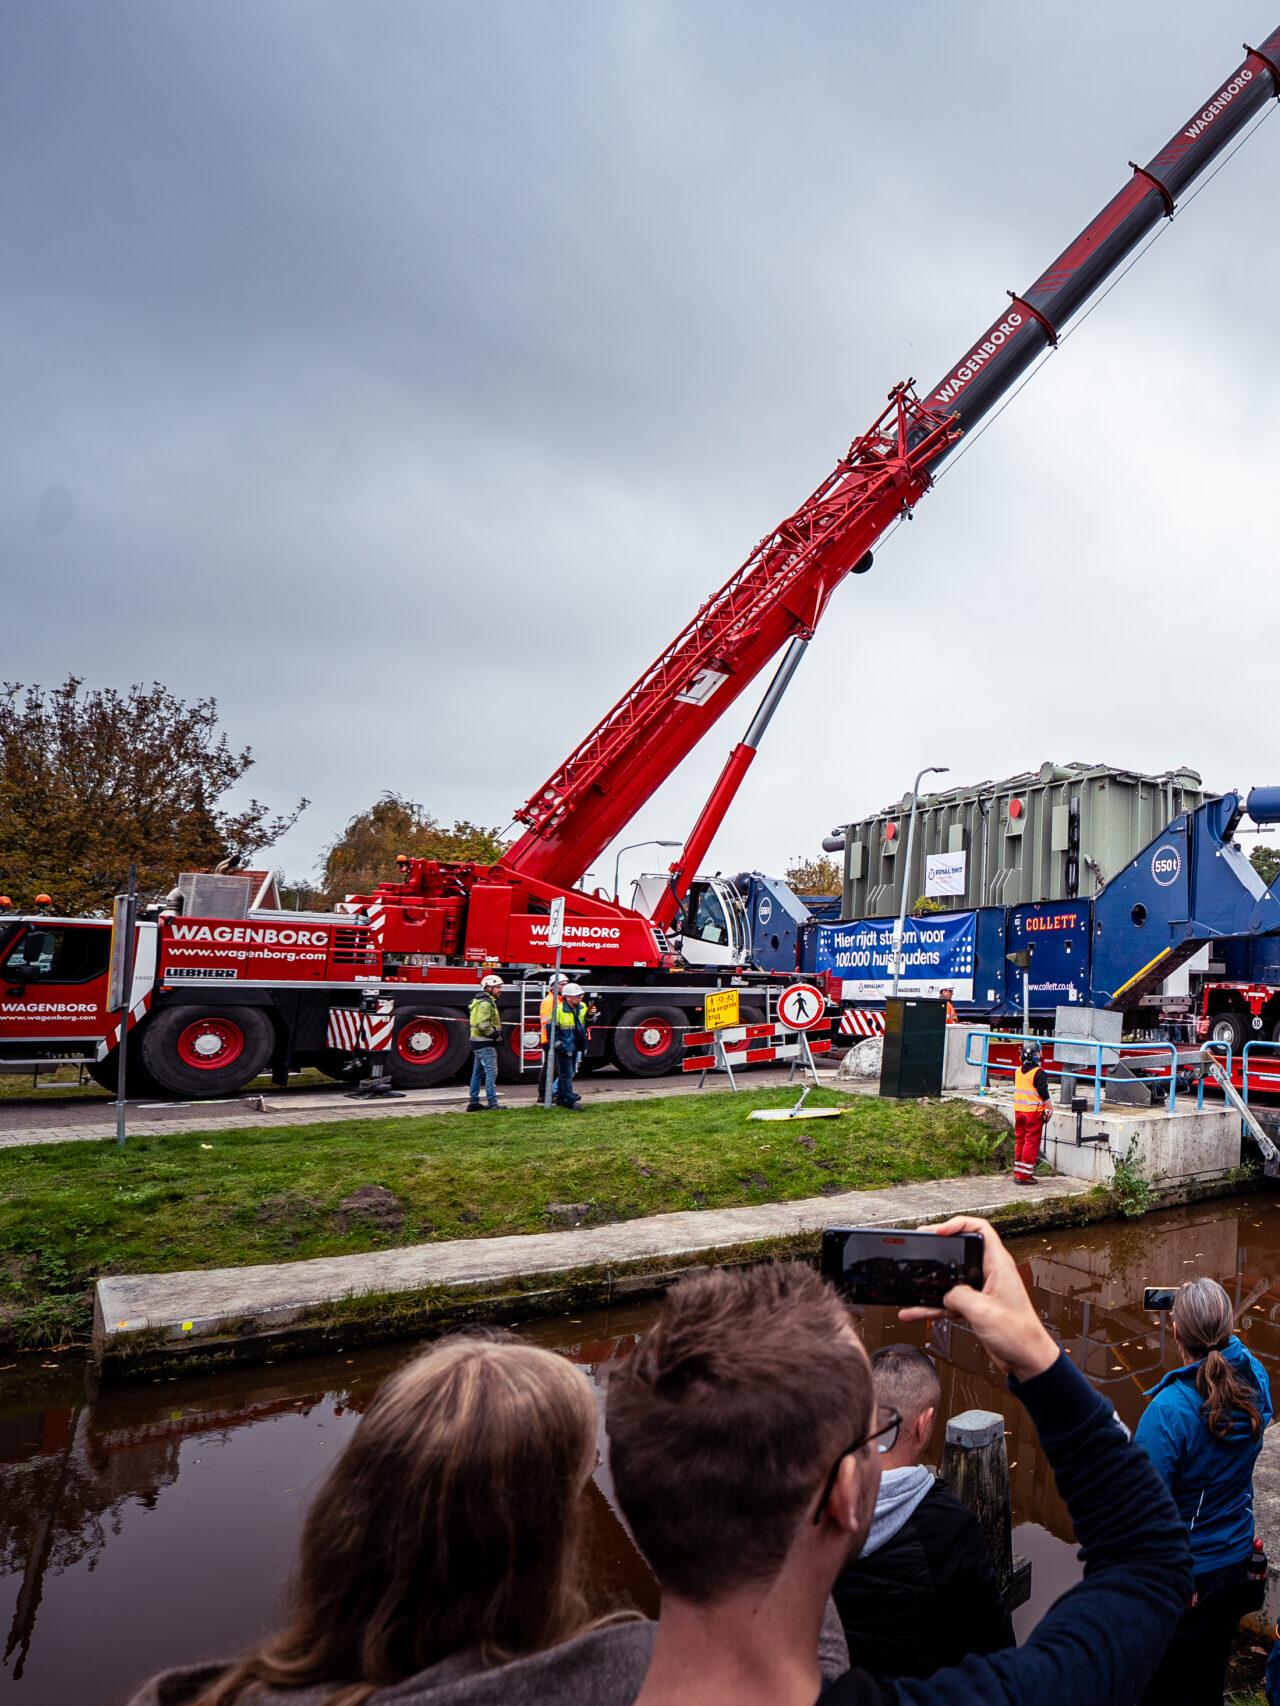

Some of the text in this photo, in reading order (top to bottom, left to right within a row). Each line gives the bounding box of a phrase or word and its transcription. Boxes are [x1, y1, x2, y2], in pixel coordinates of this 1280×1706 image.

[1185, 69, 1253, 139] WAGENBORG
[935, 313, 1022, 403] WAGENBORG
[1026, 914, 1077, 931] COLLETT
[171, 925, 329, 946] WAGENBORG
[834, 930, 945, 949] Hier rijdt strom voor
[168, 948, 327, 962] www.wagenborg.com
[836, 949, 940, 967] 100.000 huisoudens
[166, 968, 236, 978] LIEBHERR
[1026, 982, 1074, 990] ww.collett.co.uk
[1, 1003, 97, 1012] WAGENBORG
[0, 1014, 96, 1022] www.wagenborg.com
